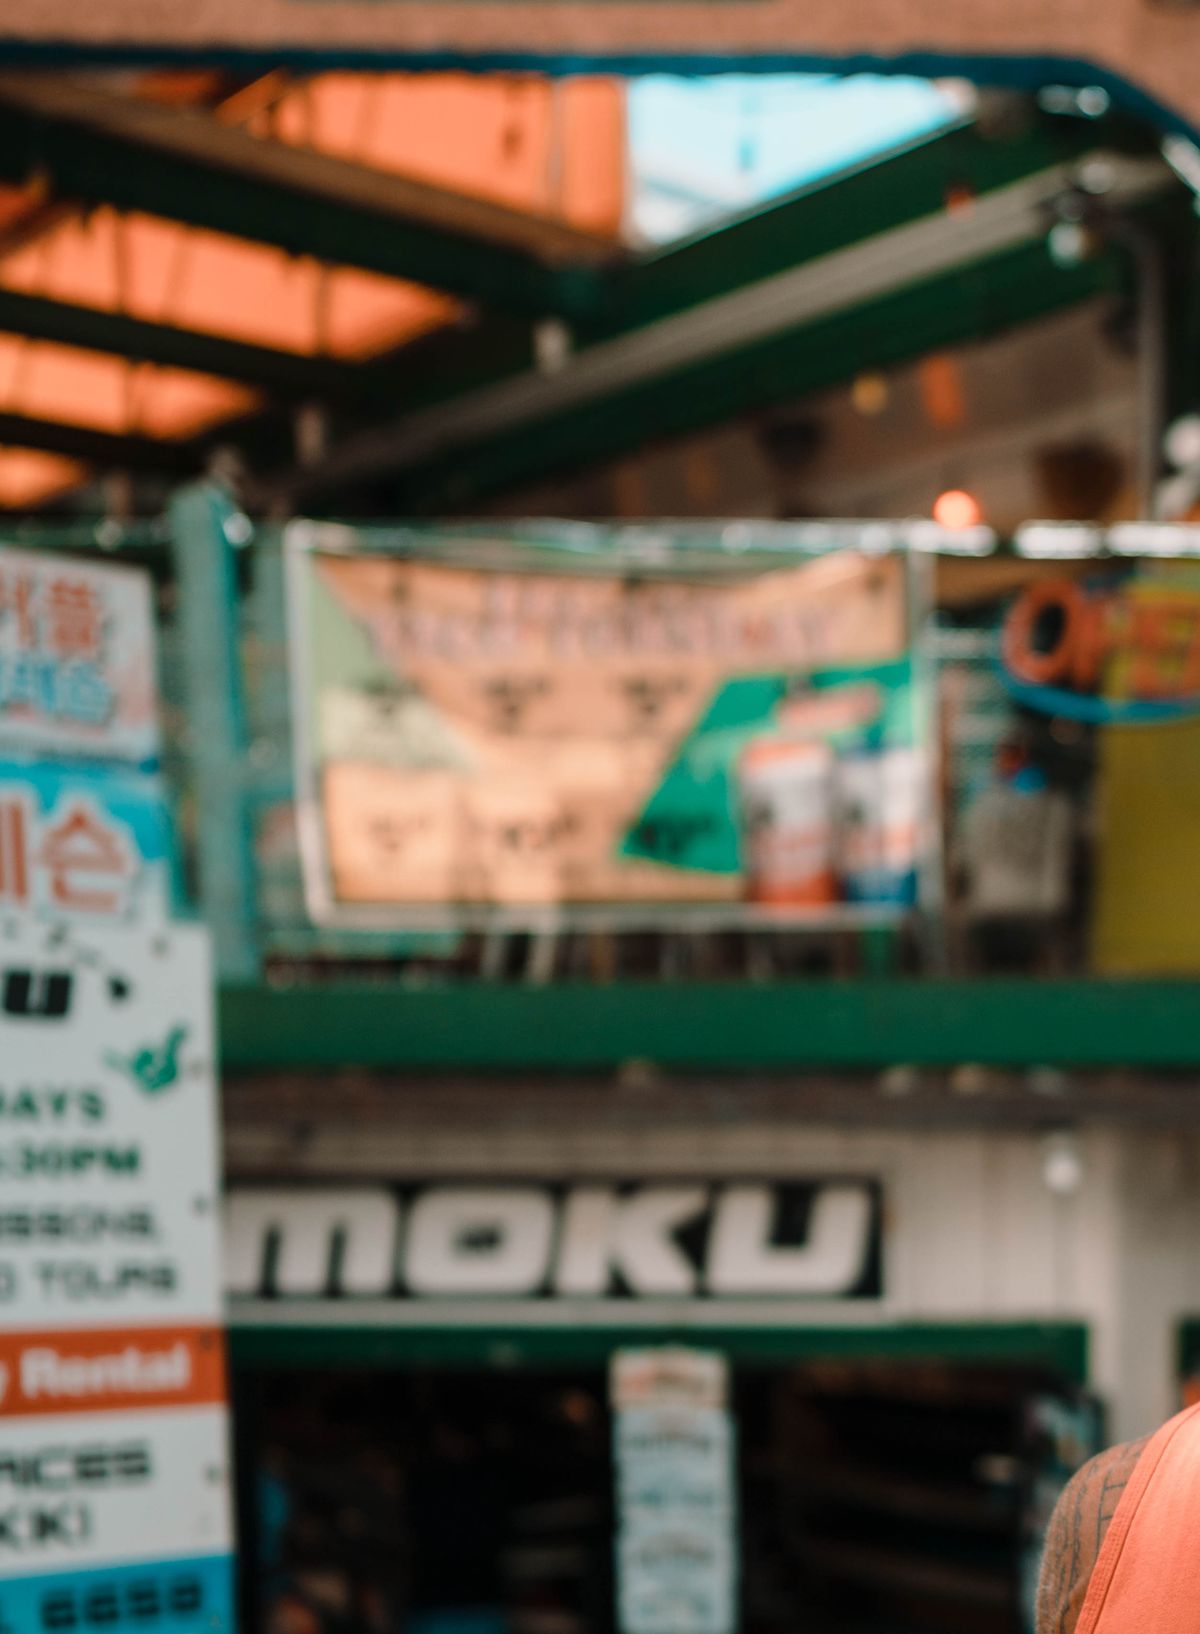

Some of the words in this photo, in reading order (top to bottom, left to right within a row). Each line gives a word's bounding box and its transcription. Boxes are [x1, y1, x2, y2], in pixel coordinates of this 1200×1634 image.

[0, 1089, 104, 1120] AYS
[224, 1186, 874, 1294] MOKU
[20, 1342, 191, 1398] Rental
